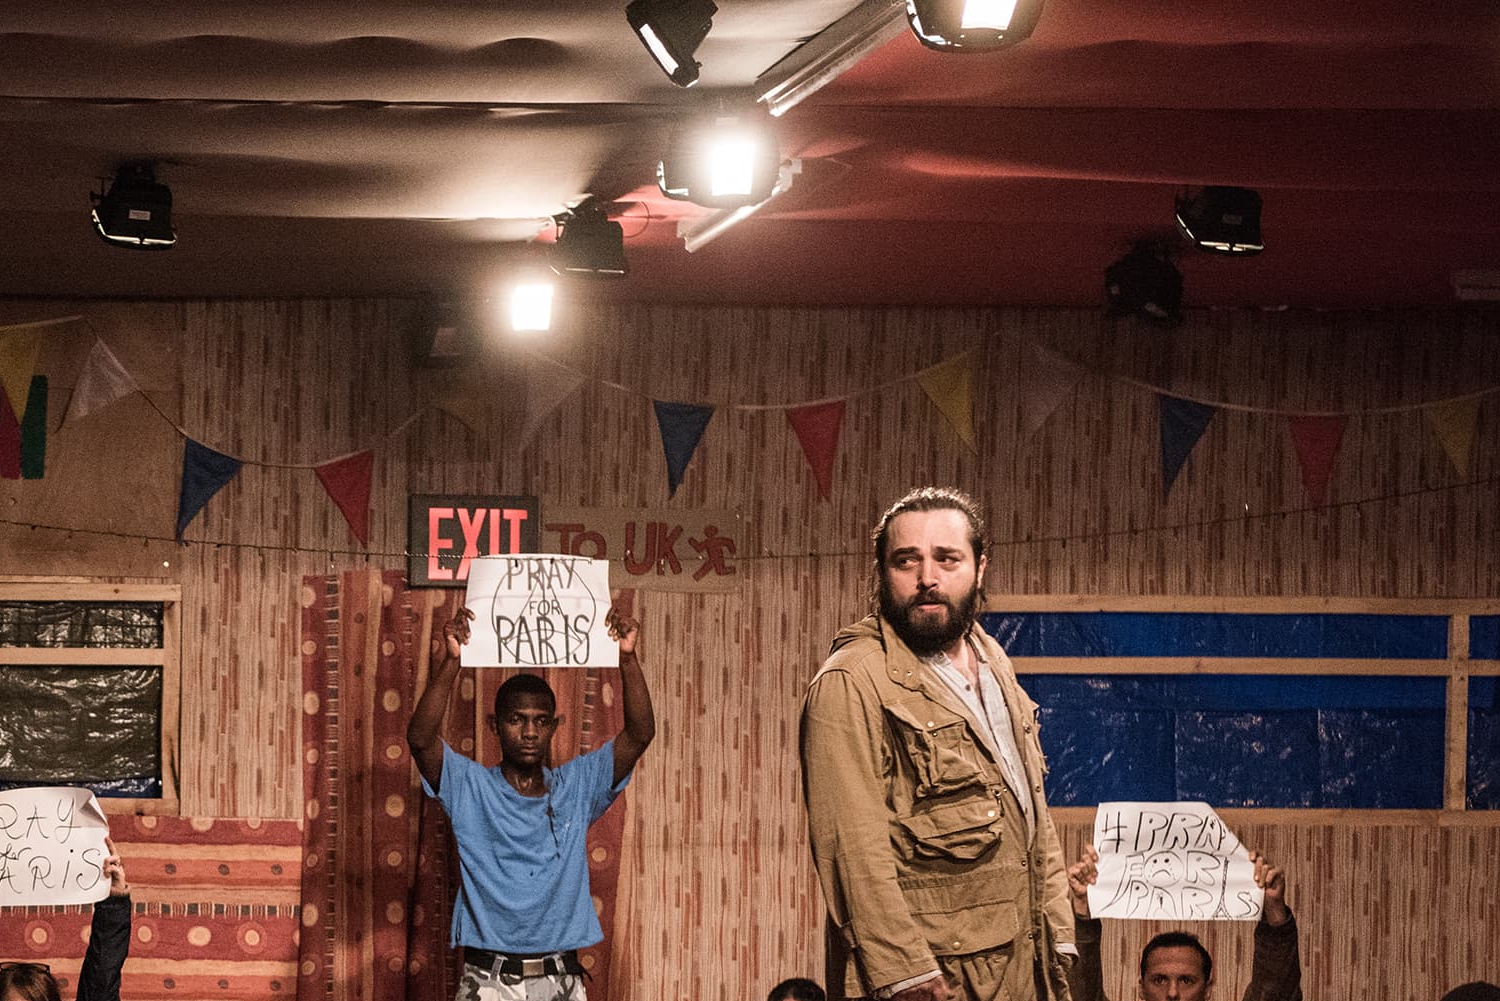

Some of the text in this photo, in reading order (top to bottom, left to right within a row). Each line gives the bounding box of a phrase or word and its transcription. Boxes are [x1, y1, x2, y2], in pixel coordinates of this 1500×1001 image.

[427, 506, 528, 580] EXIT
[624, 521, 683, 576] UK
[529, 600, 561, 617] FOR
[496, 615, 590, 665] PARIS
